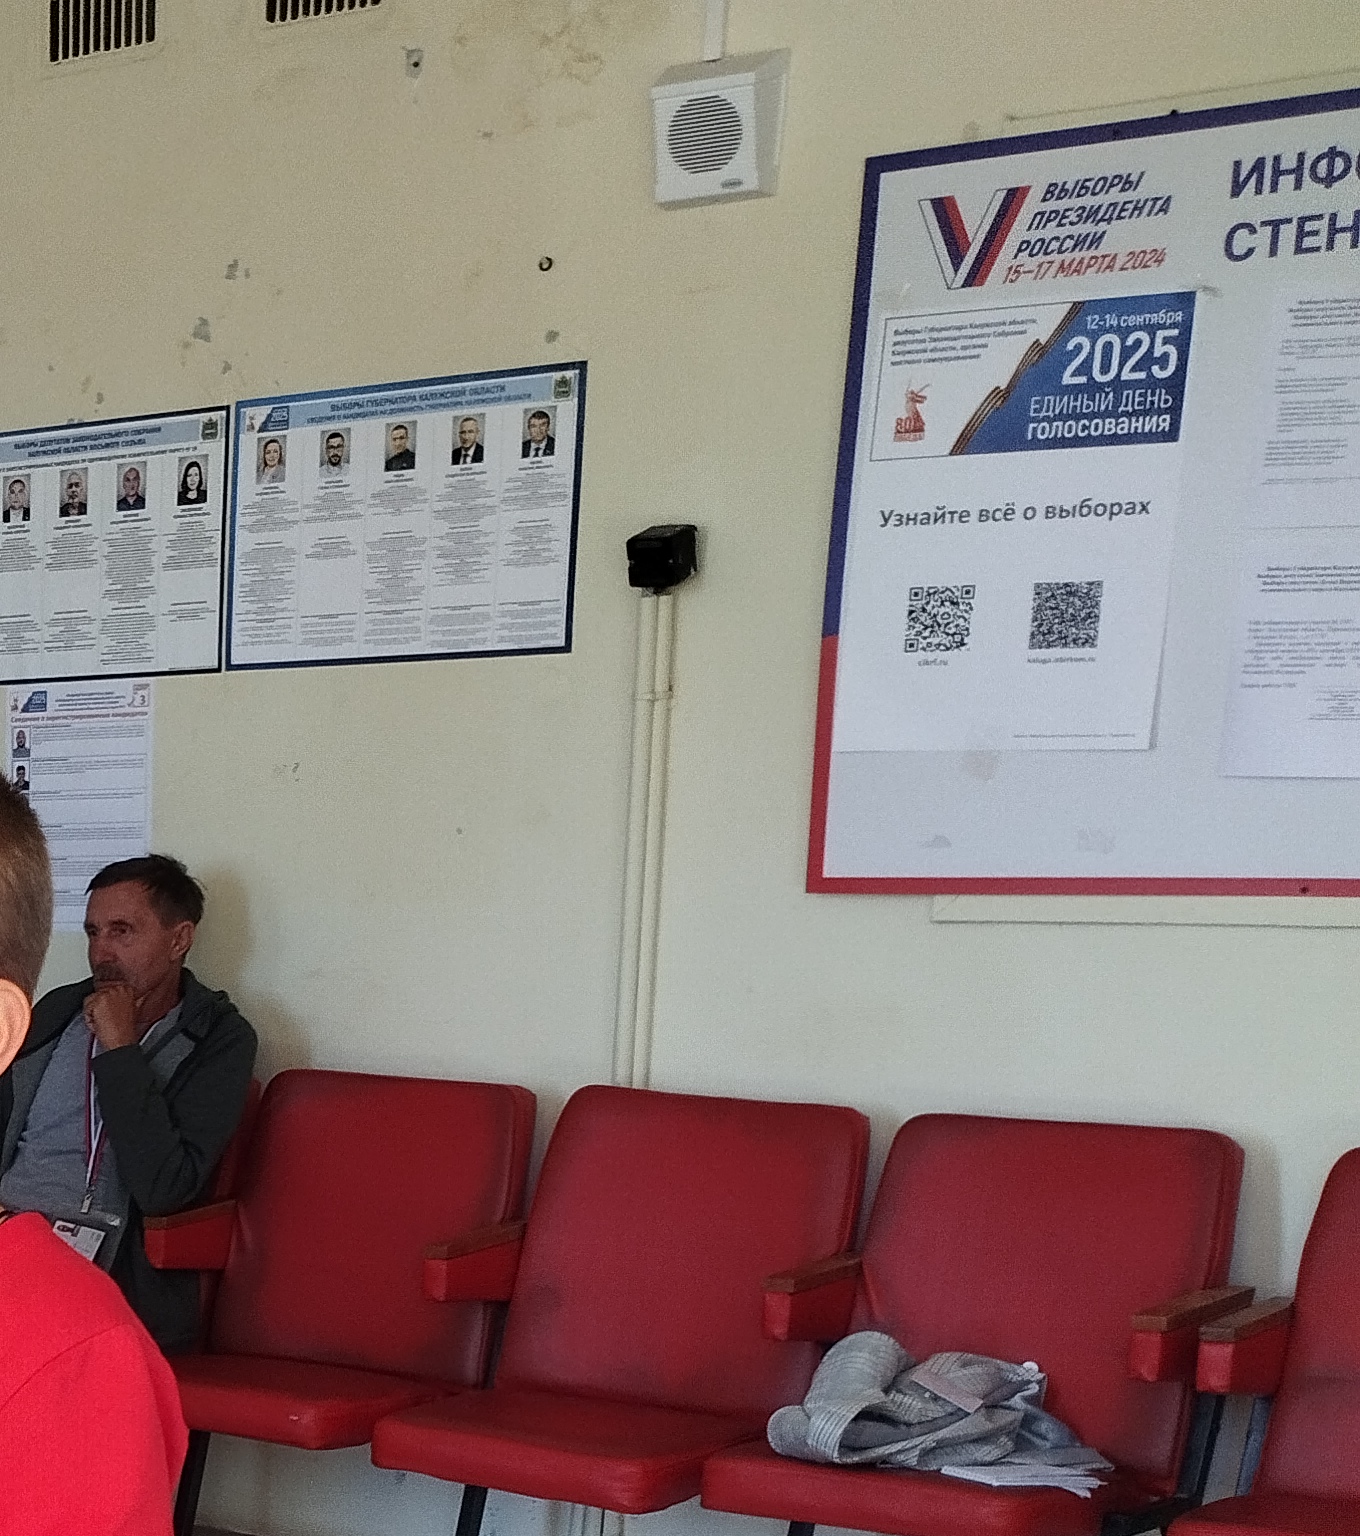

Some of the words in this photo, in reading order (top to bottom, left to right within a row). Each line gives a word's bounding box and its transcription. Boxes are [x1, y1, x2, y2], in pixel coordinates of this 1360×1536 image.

[1041, 171, 1146, 203] ВЫБОРЫ
[1230, 146, 1360, 199] ИНФ
[1026, 195, 1172, 232] ПРЕЗИДЕНТА
[1012, 230, 1108, 260] РОССИИ
[1224, 210, 1360, 262] СТЕН
[1053, 253, 1119, 279] МАРТА
[1118, 247, 1167, 272] 2024
[1085, 313, 1119, 330] 12-14
[1120, 309, 1183, 328] сентября
[1061, 328, 1180, 385] 2025
[330, 400, 365, 412] ВЫБОРЫ
[1030, 387, 1114, 418] ЕДИНЫЙ
[1118, 388, 1173, 413] ДЕНЬ
[1027, 414, 1171, 440] голосования
[879, 505, 971, 528] Узнайте
[978, 502, 1015, 523] всё
[1023, 506, 1037, 520] о
[1044, 497, 1151, 522] выборах
